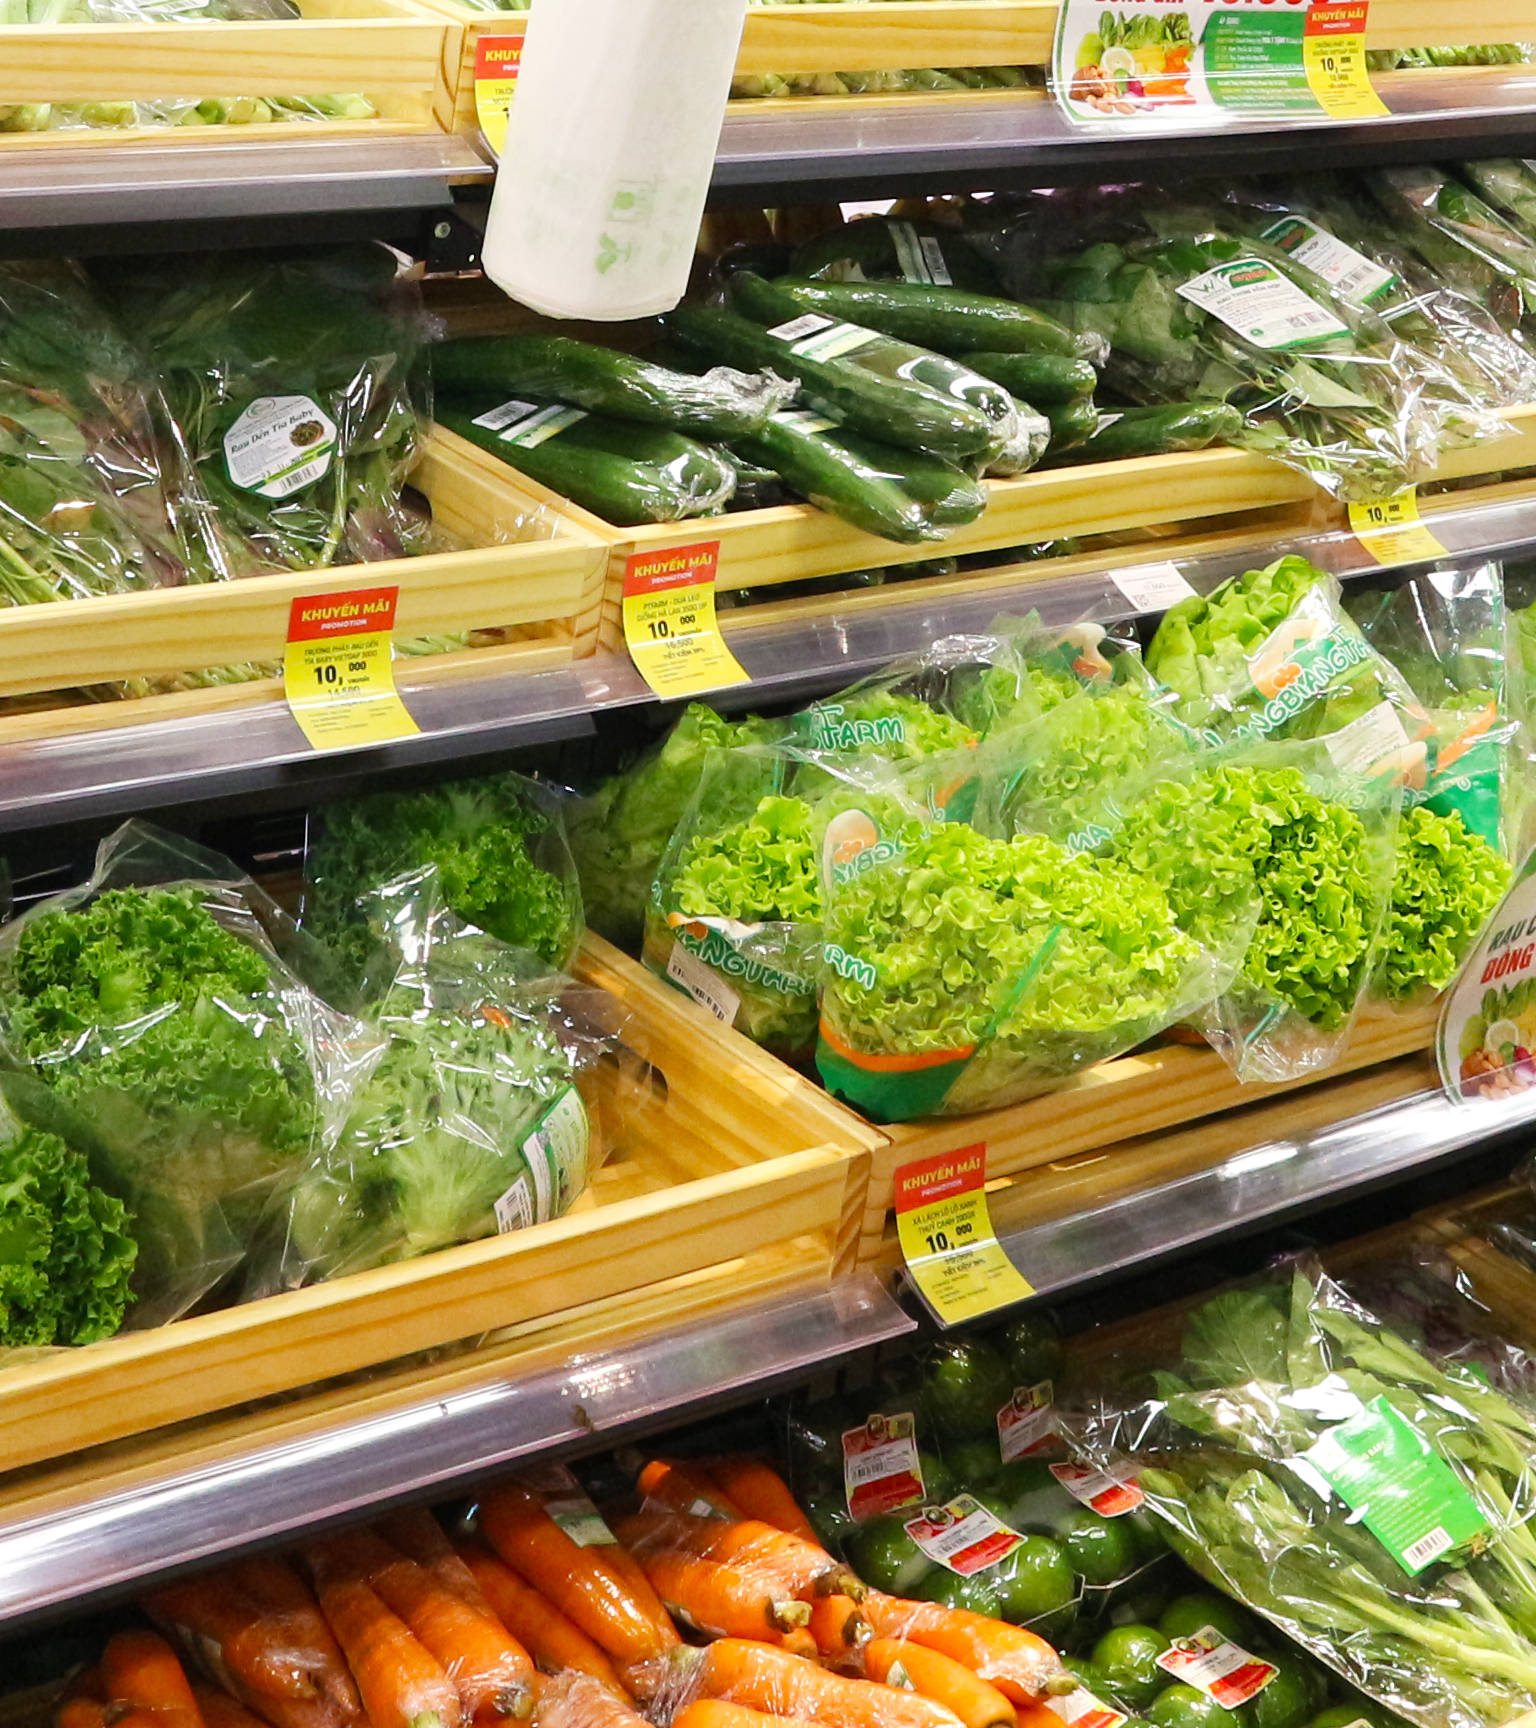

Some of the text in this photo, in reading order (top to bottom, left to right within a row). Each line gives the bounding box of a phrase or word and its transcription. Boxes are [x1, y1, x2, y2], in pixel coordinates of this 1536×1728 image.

[485, 49, 524, 62] KHUY
[634, 553, 713, 578] KHUYẾN MÃI
[301, 598, 391, 622] KHUYẾN MÃI
[313, 665, 344, 686] 10,
[1488, 922, 1524, 953] RAU
[903, 1157, 980, 1192] KHUYẾN MÃI
[925, 1232, 954, 1253] 10,
